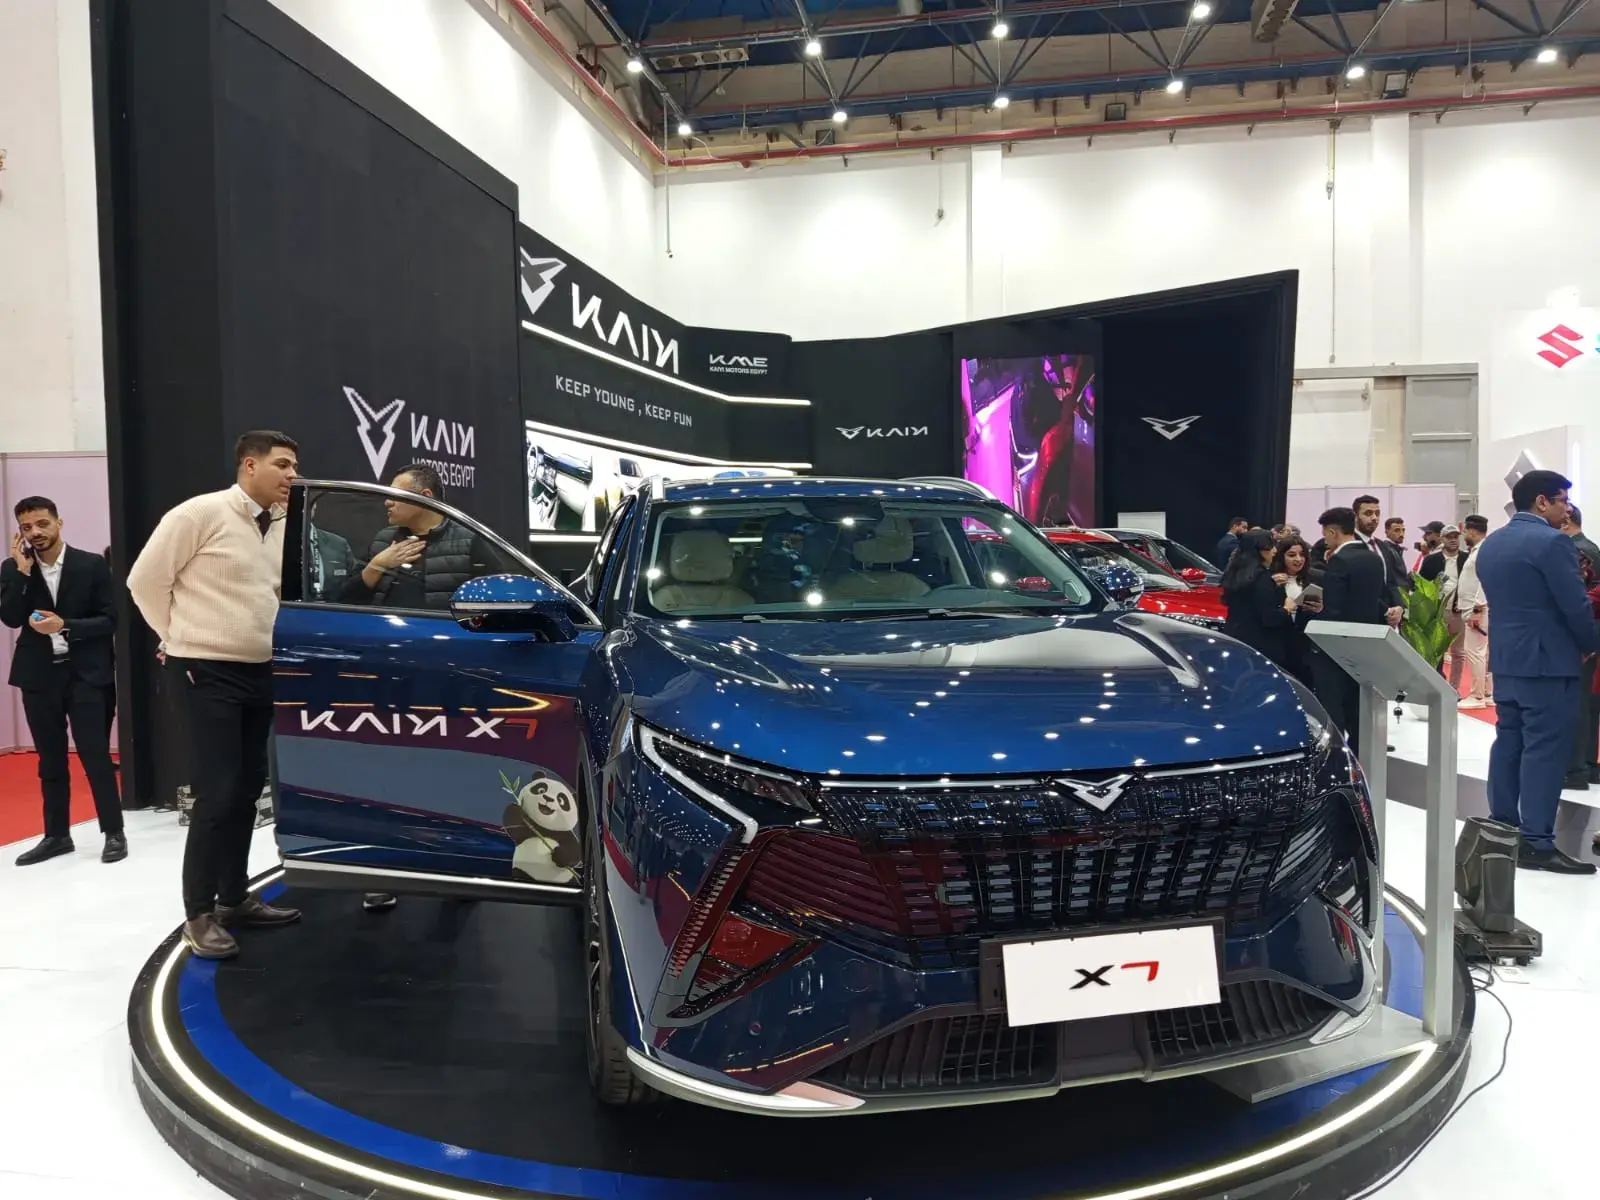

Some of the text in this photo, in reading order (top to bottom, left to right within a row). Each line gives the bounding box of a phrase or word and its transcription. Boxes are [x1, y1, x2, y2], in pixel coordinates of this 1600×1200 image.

[555, 375, 590, 398] KEEP
[593, 386, 635, 412] YOUNG
[644, 402, 671, 421] KEEP
[673, 412, 692, 427] FUN
[449, 463, 476, 489] EGYPT
[465, 715, 539, 740] X7
[1069, 961, 1160, 990] X7
